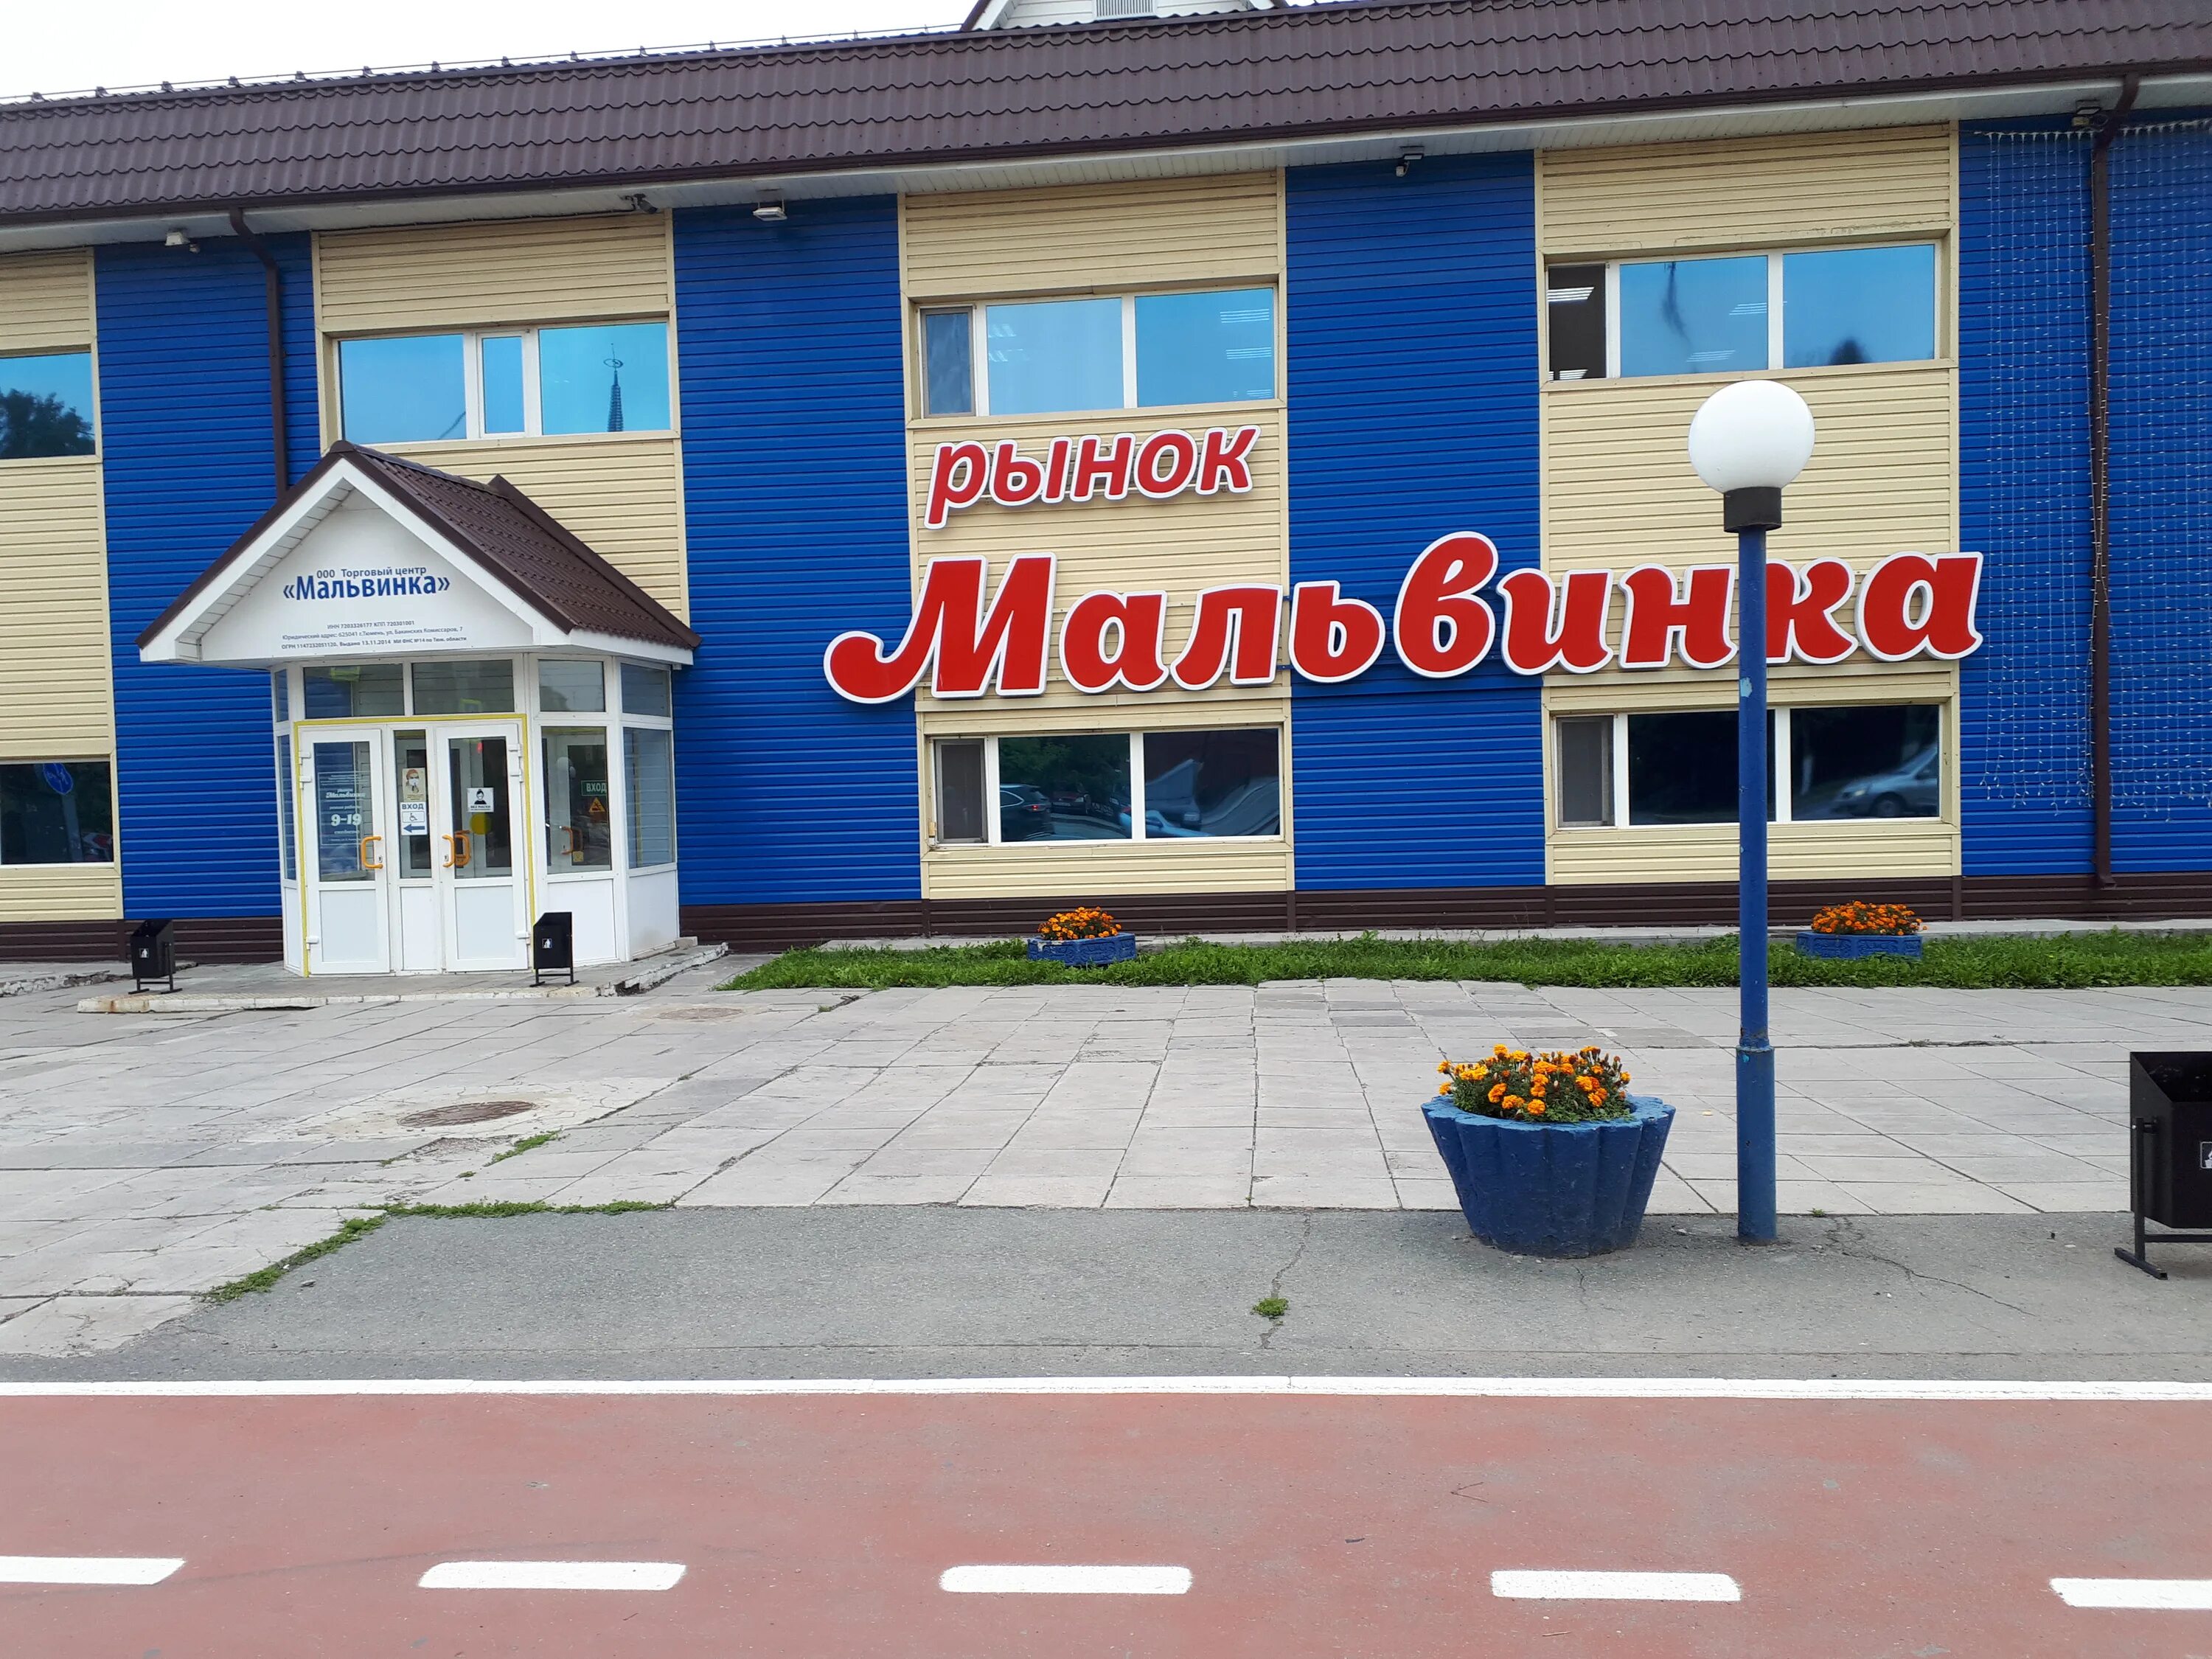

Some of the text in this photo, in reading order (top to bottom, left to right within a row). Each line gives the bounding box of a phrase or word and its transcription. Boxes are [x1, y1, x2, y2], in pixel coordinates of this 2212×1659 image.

[925, 425, 1260, 529] рынок
[316, 566, 426, 579] ООО Торговый центр
[283, 575, 451, 600] «Мальвинка»
[823, 530, 1984, 704] Мальвинка
[586, 782, 607, 793] ВХОД
[330, 813, 362, 827] 9-19
